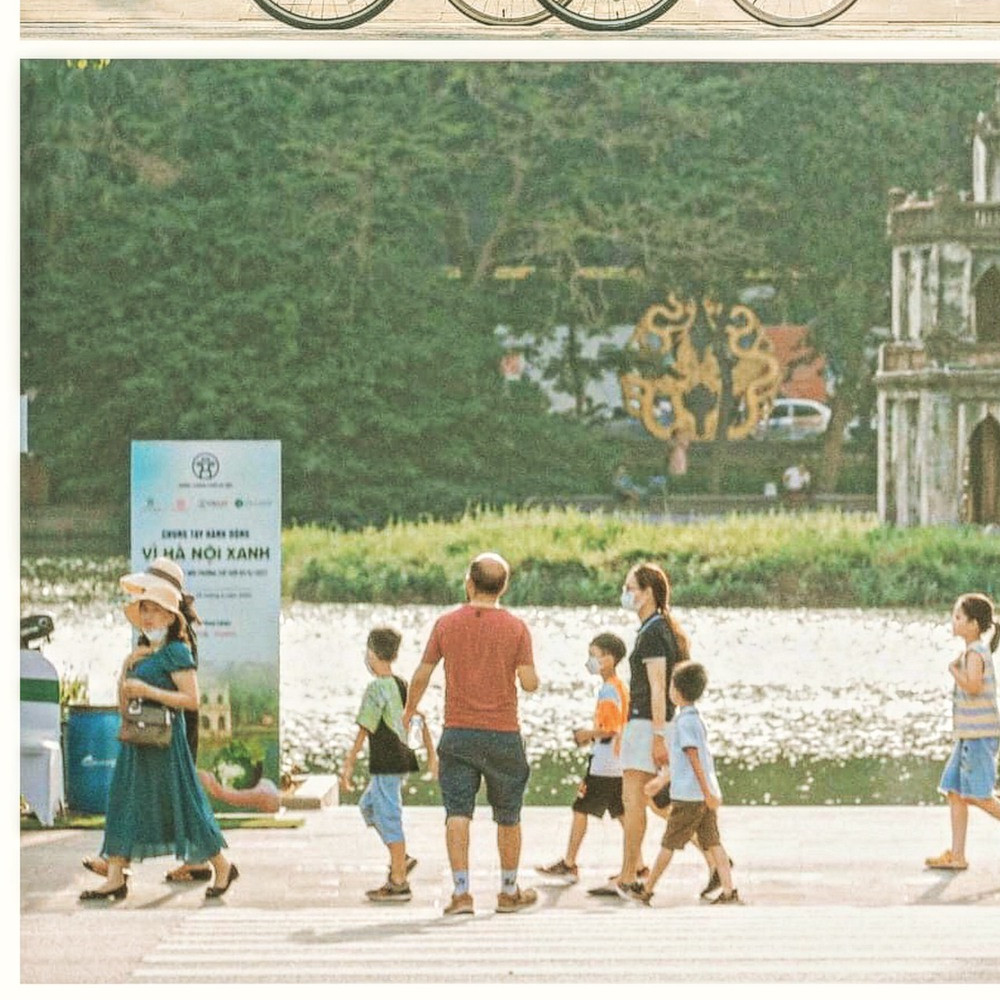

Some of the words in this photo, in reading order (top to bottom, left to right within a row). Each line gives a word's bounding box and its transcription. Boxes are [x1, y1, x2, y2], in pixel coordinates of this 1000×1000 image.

[142, 543, 157, 560] VÌ
[163, 543, 186, 560] HÀ
[191, 544, 222, 562] NỘI
[227, 546, 271, 560] XANH
